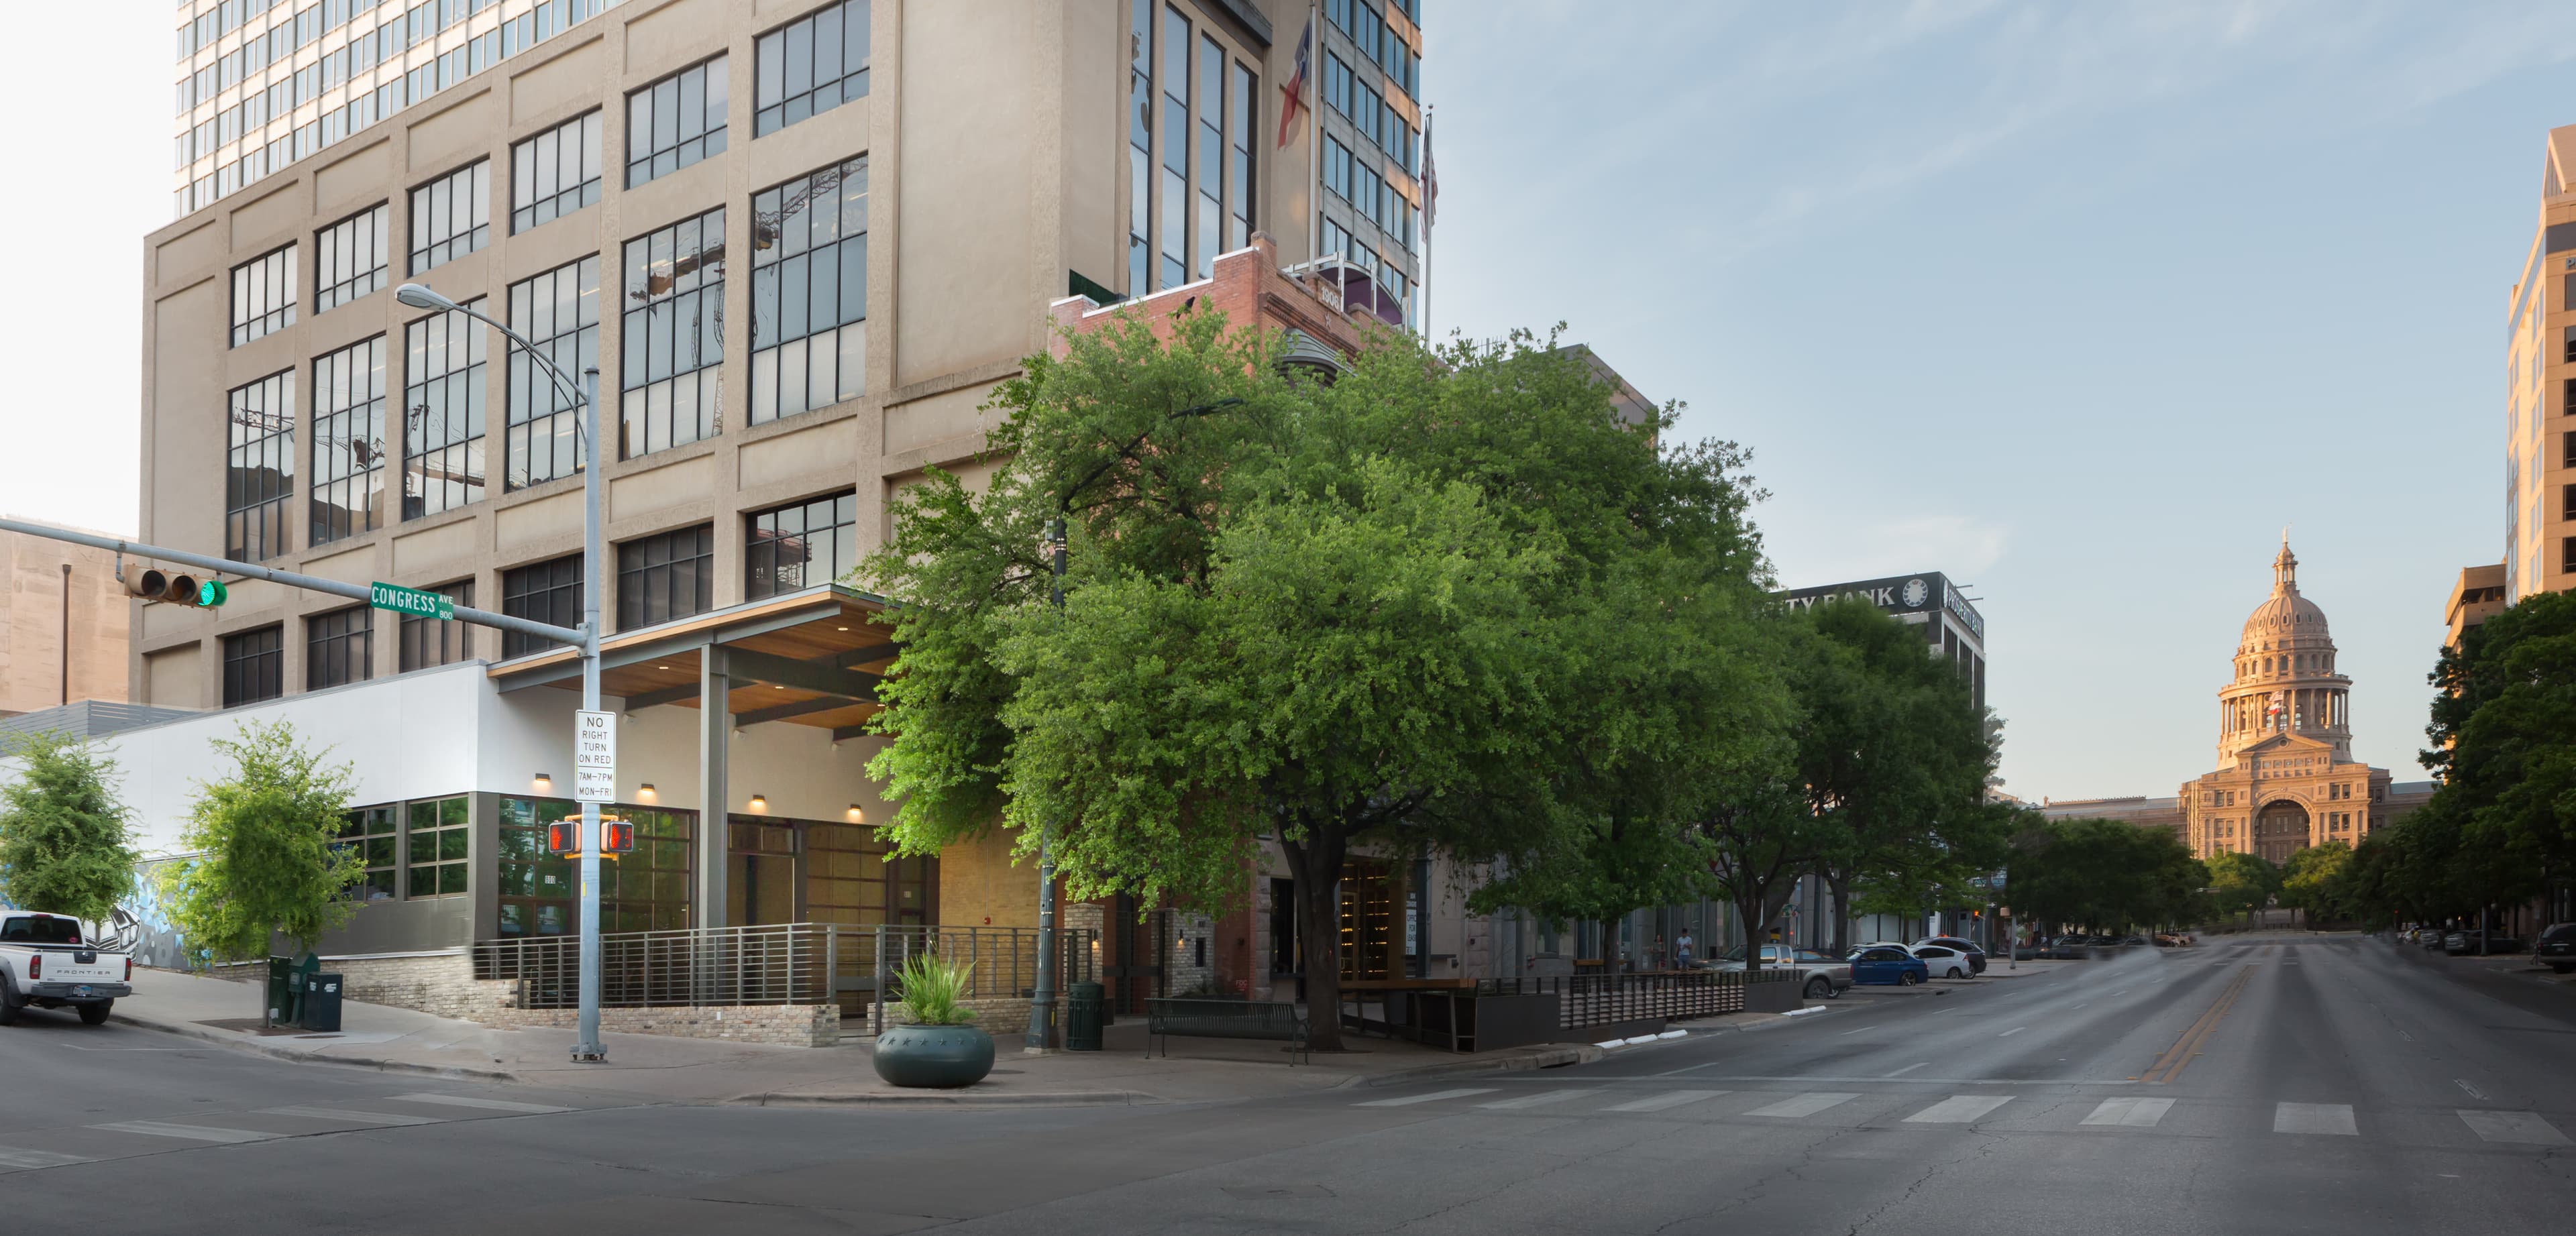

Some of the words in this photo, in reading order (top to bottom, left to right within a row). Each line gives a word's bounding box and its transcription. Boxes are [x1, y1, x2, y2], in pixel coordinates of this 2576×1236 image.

[1321, 286, 1339, 310] 1906
[372, 586, 435, 613] CONGRESS
[439, 595, 453, 605] AVE
[439, 610, 453, 620] 800
[587, 717, 603, 728] NO
[582, 730, 608, 740] RIGHT
[584, 742, 606, 752] TURN
[579, 754, 590, 763] ON
[594, 755, 611, 764] RED
[579, 773, 612, 782] 7AM-7PM
[579, 787, 612, 796] MON-FRI
